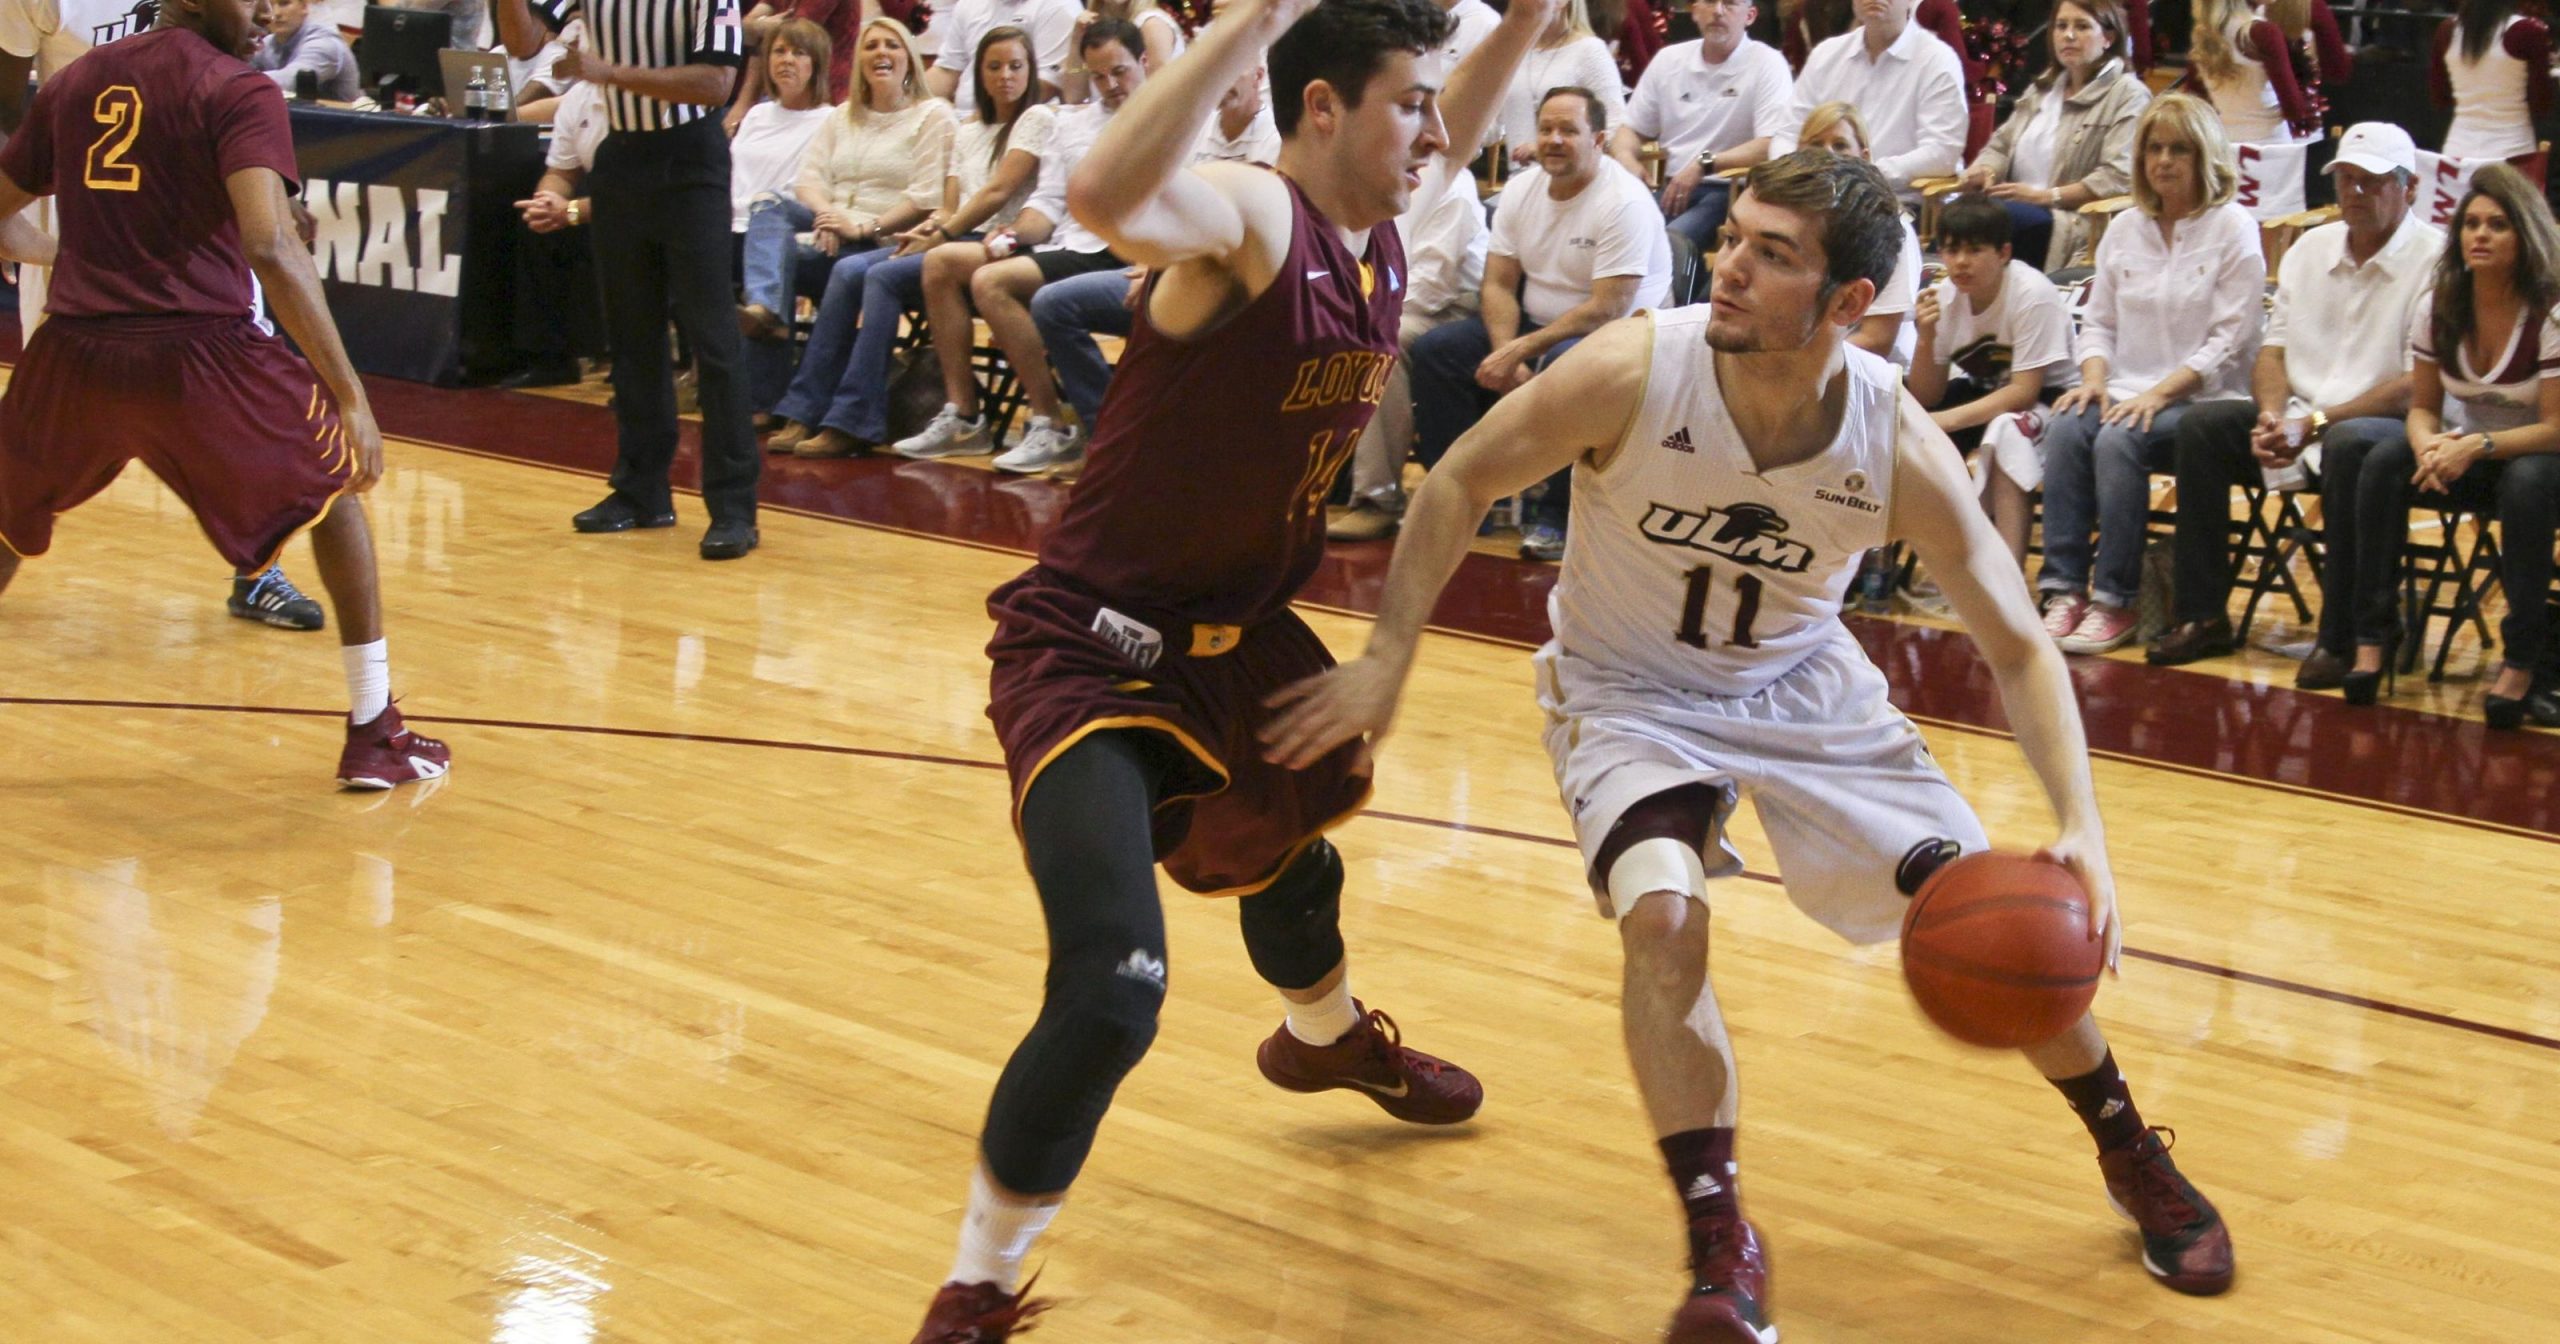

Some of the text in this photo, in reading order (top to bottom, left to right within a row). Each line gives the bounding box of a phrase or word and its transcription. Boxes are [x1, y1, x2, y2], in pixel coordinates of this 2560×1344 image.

[84, 85, 143, 191] 2
[2431, 156, 2461, 225] LM
[297, 178, 462, 298] NAL
[1287, 427, 1360, 522] 14
[1661, 440, 1695, 454] adidas
[1638, 500, 1815, 573] ULM
[1675, 562, 1763, 649] 11
